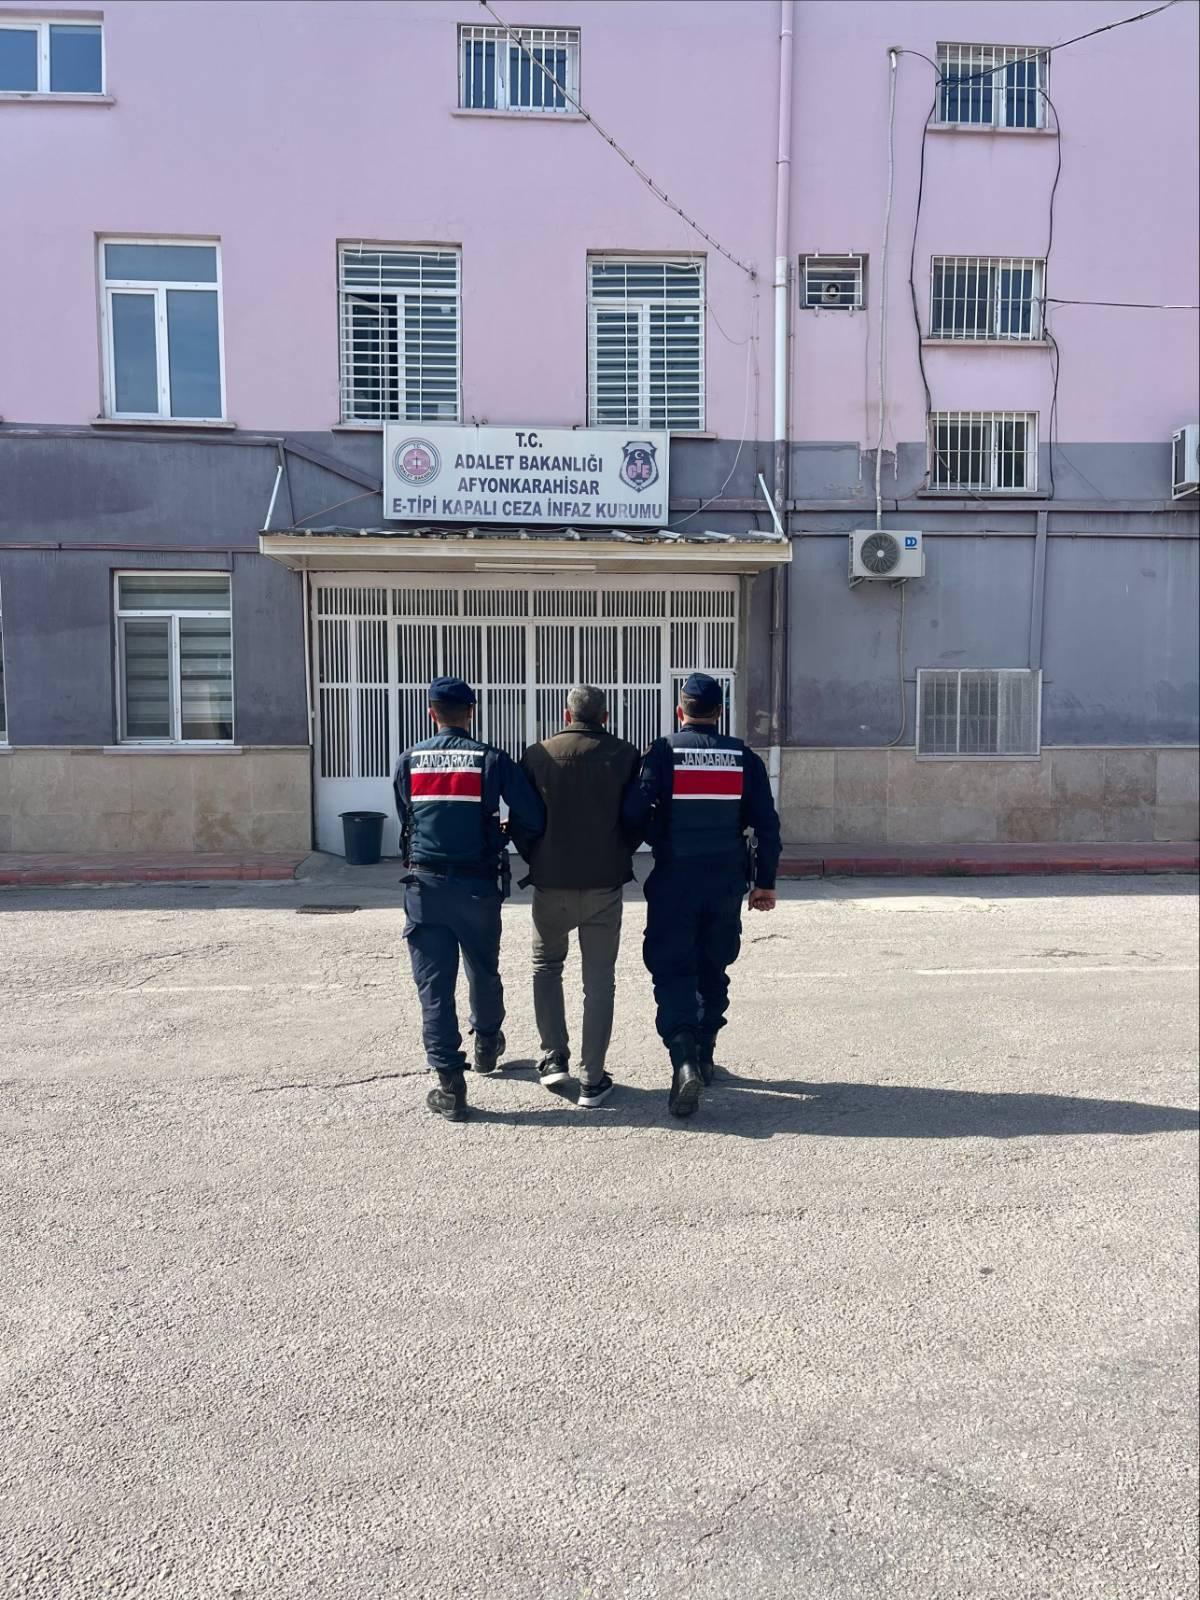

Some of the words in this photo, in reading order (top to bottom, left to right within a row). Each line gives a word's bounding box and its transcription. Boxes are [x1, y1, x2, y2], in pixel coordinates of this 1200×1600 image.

[515, 432, 543, 448] T.C.
[454, 454, 514, 471] ADALET
[519, 454, 603, 473] BAKANLIĞI
[457, 476, 600, 495] AFYONKARAHİSAR
[392, 495, 437, 514] E-TİPİ
[442, 499, 497, 516] KAPALI
[502, 501, 542, 517] CEZA
[547, 498, 591, 518] İNFAZ
[595, 503, 663, 519] KURUMU
[416, 754, 475, 768] JANDARMA
[681, 752, 737, 767] JANDARMA
